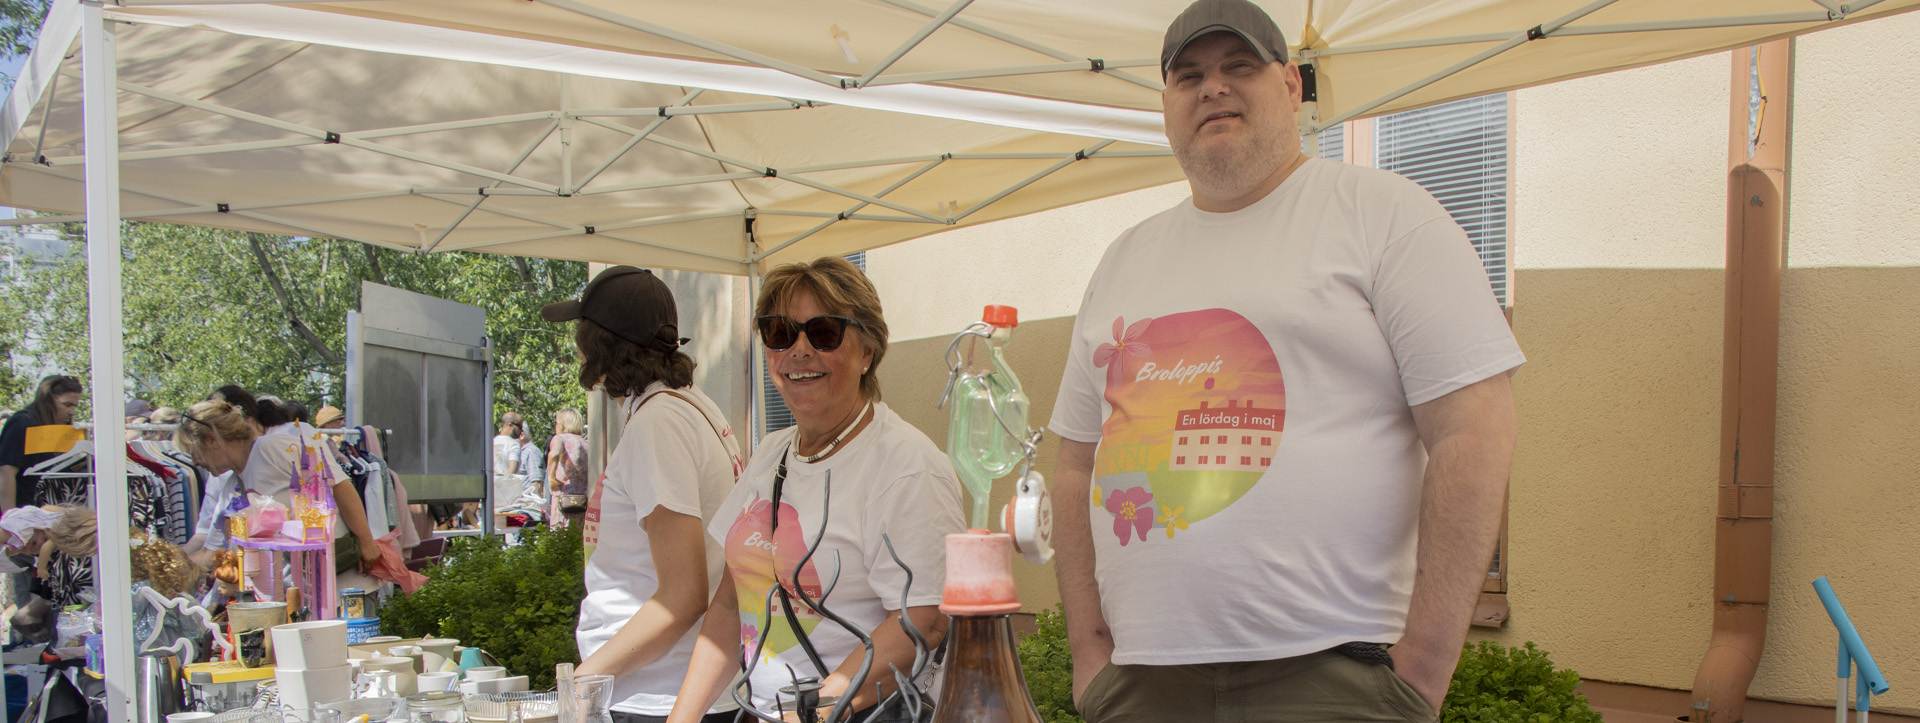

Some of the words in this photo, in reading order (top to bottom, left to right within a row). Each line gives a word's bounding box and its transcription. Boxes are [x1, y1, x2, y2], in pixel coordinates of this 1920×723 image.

[1135, 355, 1223, 385] Broloppis
[1182, 414, 1196, 426] En
[1199, 411, 1240, 427] lördag
[1243, 413, 1248, 424] i
[1251, 414, 1276, 429] maj
